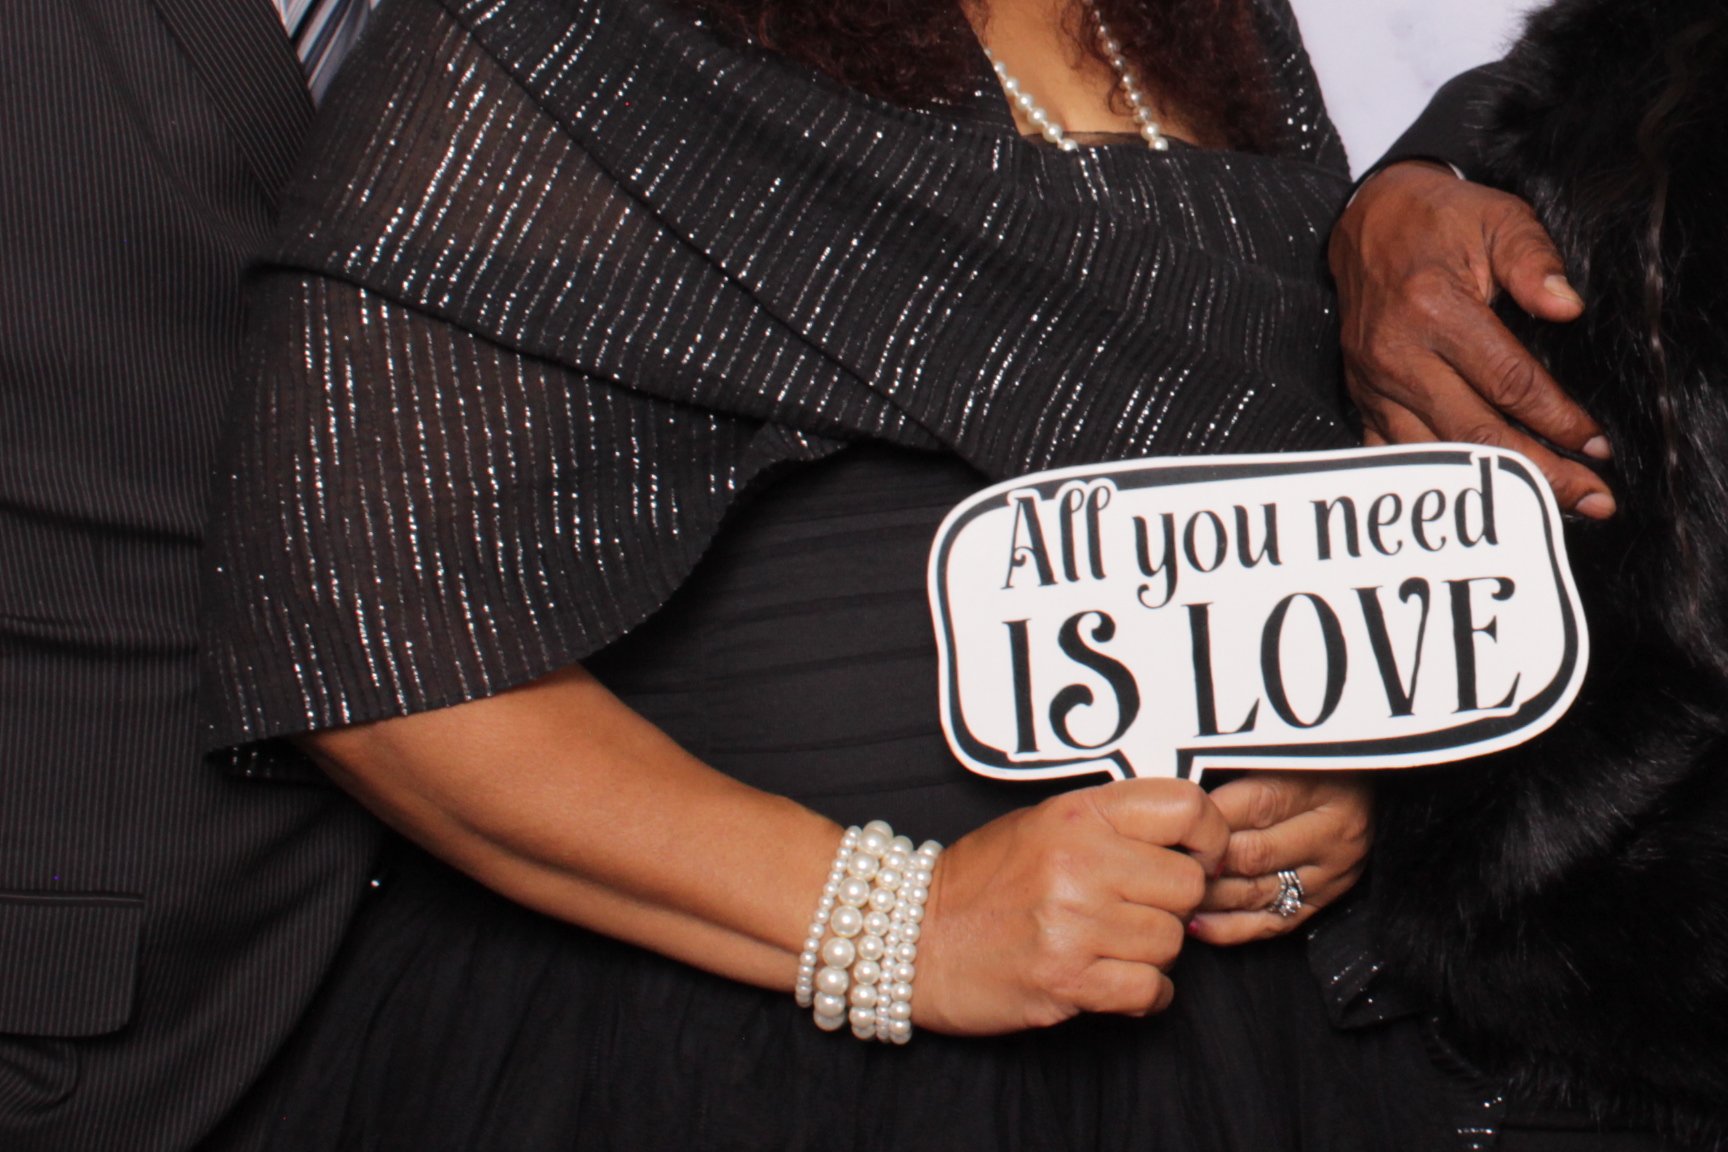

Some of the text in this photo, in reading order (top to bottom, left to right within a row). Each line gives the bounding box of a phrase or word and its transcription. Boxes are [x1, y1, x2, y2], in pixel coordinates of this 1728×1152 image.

[1000, 456, 1501, 609] All you need
[1001, 576, 1522, 755] IS LOVE
